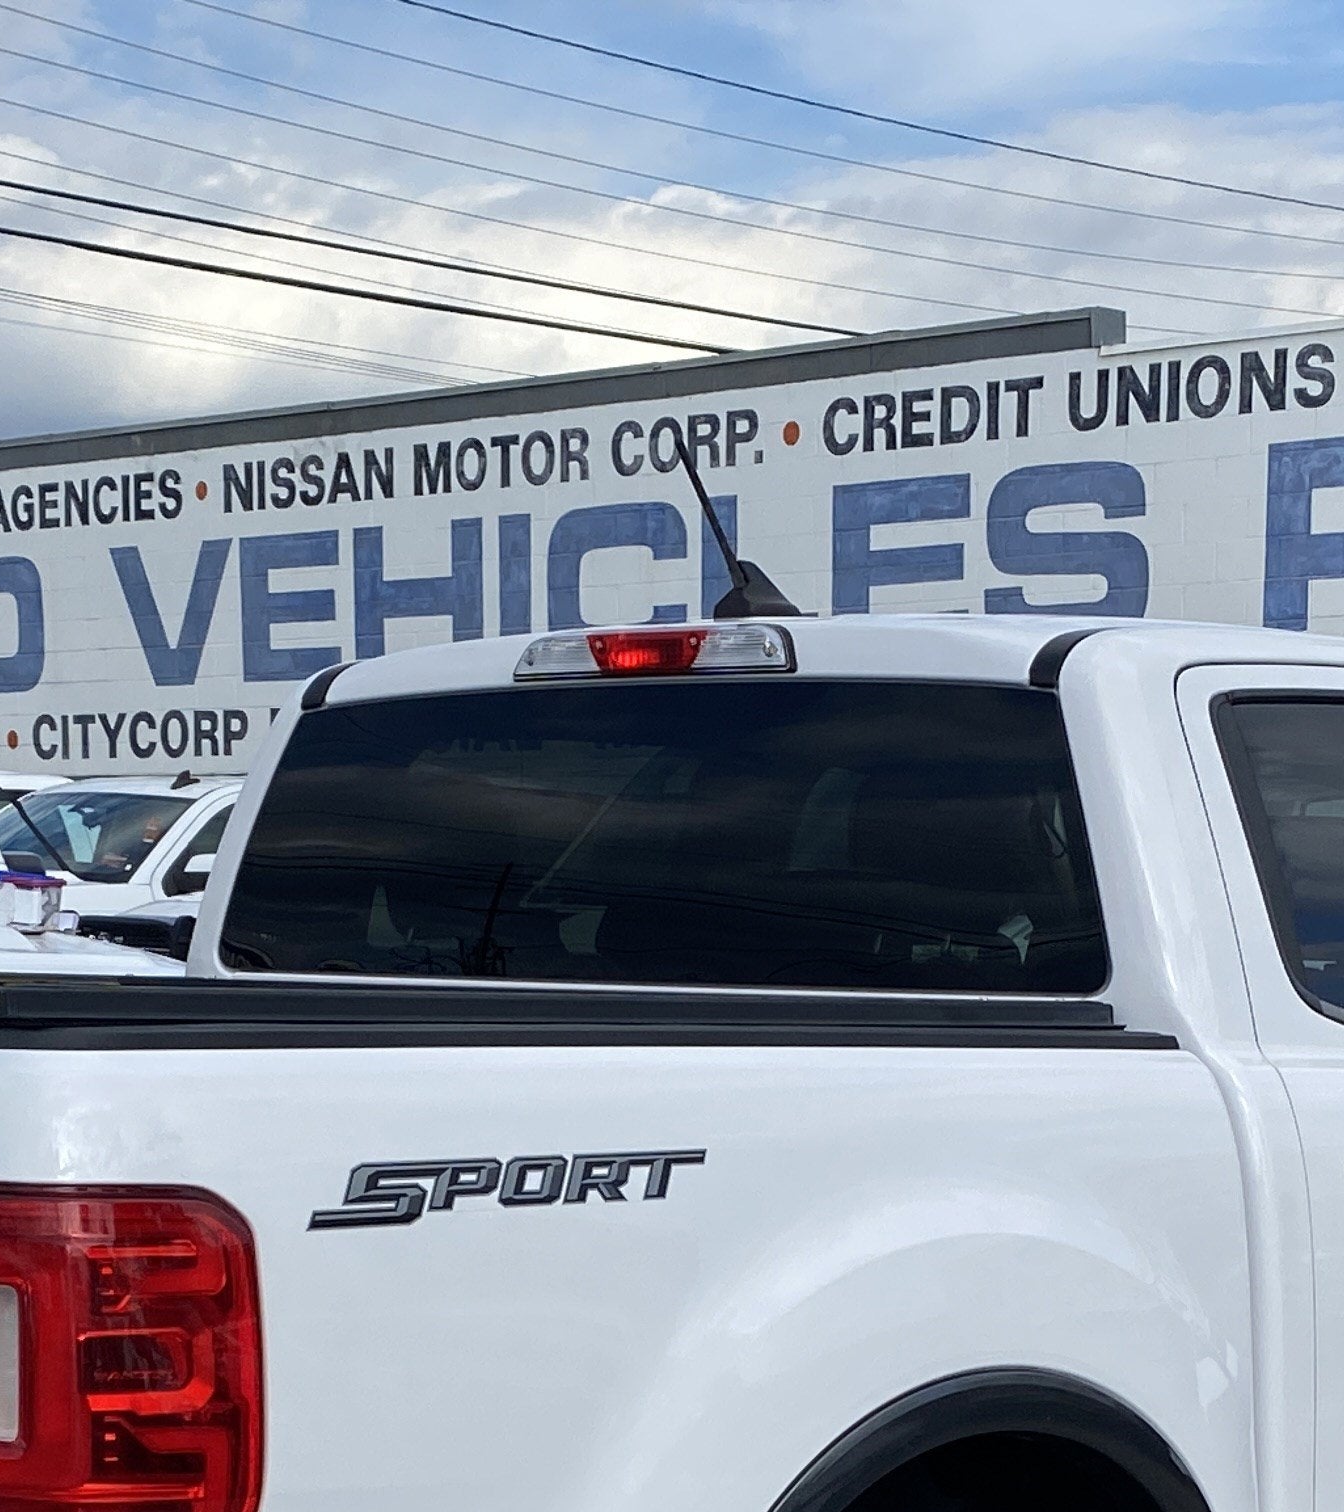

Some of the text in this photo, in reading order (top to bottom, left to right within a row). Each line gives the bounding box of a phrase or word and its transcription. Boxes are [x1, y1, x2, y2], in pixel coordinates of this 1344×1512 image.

[223, 446, 395, 512] NISSAN
[413, 426, 590, 497] MOTOR
[611, 407, 765, 478] CORP.
[822, 375, 1045, 457] CREDIT
[1067, 342, 1336, 434] UNIONS
[32, 709, 248, 761] CITYCORP
[306, 1148, 708, 1232] SPORT
